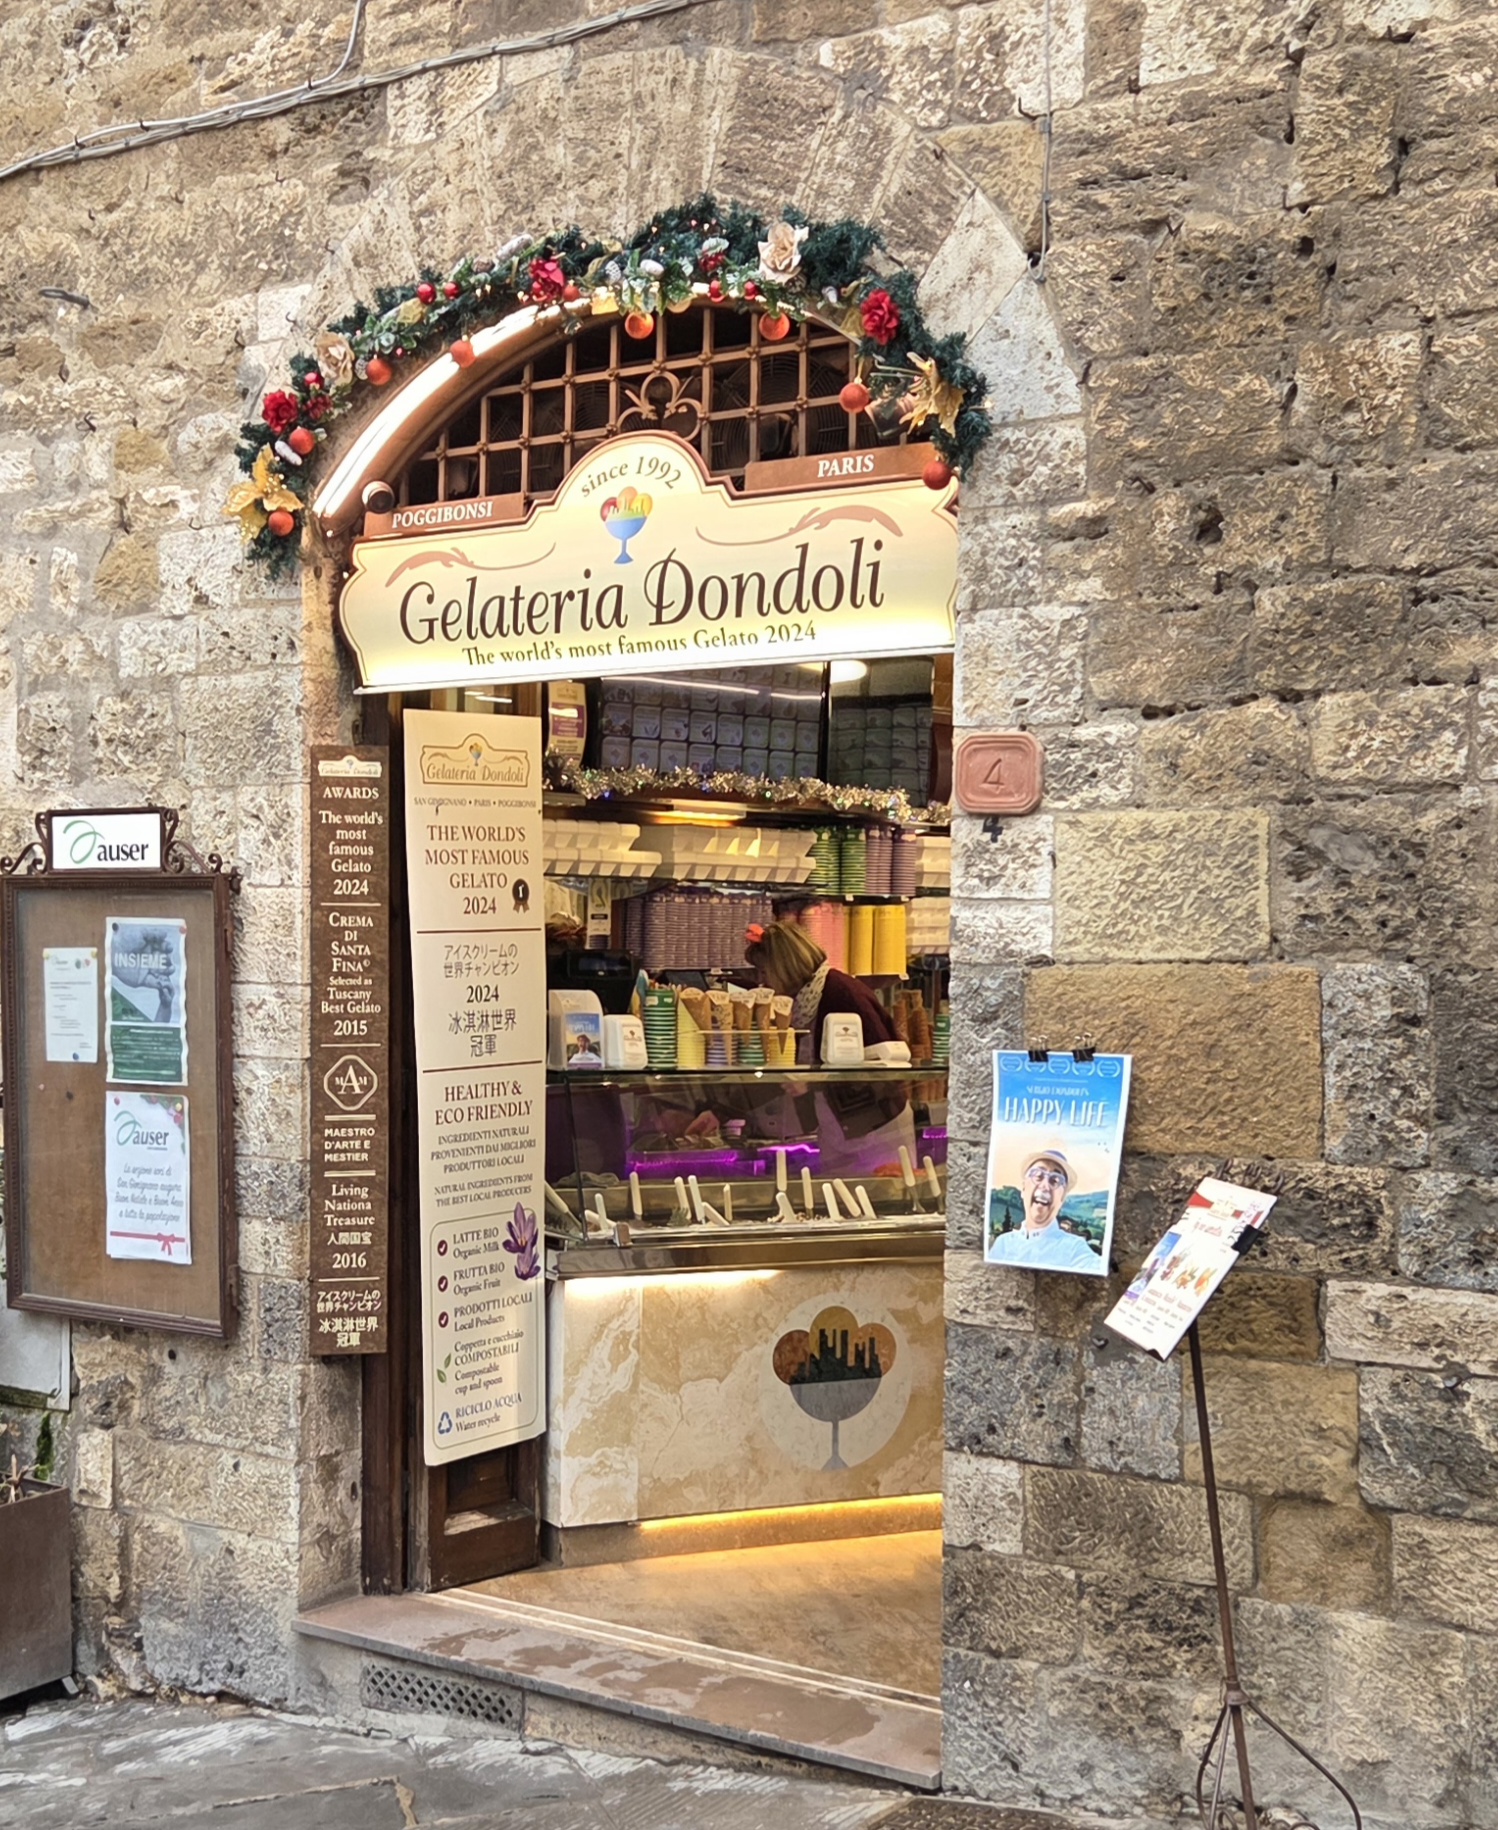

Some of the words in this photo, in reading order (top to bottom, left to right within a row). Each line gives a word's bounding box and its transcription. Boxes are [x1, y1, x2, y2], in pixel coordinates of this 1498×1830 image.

[817, 454, 875, 478] PARIS
[581, 463, 628, 497] since
[636, 456, 681, 489] 1992
[392, 501, 494, 529] POGGIBONSI
[400, 568, 628, 645] Gelateria
[644, 537, 884, 626] Dondoli
[462, 646, 495, 665] The
[500, 640, 562, 663] world's
[569, 640, 612, 658] most
[618, 635, 687, 655] famous
[694, 627, 758, 649] Gelato
[765, 620, 816, 644] 2024
[426, 763, 477, 781] Gelateria
[481, 764, 524, 783] Dondoli
[979, 758, 1005, 795] 4
[323, 786, 379, 799] AWARDS
[318, 810, 342, 824] The
[344, 811, 383, 825] world's
[336, 829, 366, 840] most
[427, 825, 460, 841] THE
[462, 825, 526, 842] WORLD'S
[97, 842, 149, 862] auser
[329, 841, 374, 855] famous
[425, 849, 468, 865] MOST
[472, 850, 529, 865] FAMOUS
[331, 858, 372, 873] Gelato
[333, 878, 369, 895] 2024
[449, 872, 508, 889] GELATO
[463, 896, 497, 915] 2024
[329, 912, 374, 927] CREMA
[344, 930, 358, 941] DI
[331, 941, 371, 956] SANTA
[443, 943, 518, 961] アイスクリームの
[114, 952, 168, 969] INSIEME
[443, 959, 520, 979] 世界チャンピオン
[329, 976, 362, 986] Selected
[363, 978, 372, 986] as
[327, 987, 372, 1003] Tuscany
[466, 984, 500, 1003] 2024
[321, 1001, 344, 1014] Best
[347, 1001, 381, 1014] Gelato
[333, 1019, 368, 1036] 2015
[448, 1007, 517, 1035] 冰淇淋世界
[470, 1033, 498, 1058] 冠軍
[445, 1081, 510, 1102] HEALTHY
[511, 1080, 522, 1096] &
[435, 1107, 465, 1126] ECO
[467, 1099, 533, 1122] FRIENDLY
[1004, 1096, 1064, 1126] HAPPY
[1070, 1099, 1109, 1128] LIFE
[132, 1130, 169, 1146] auser
[324, 1128, 375, 1137] MAESTRO
[438, 1130, 491, 1145] INGREDIENTI
[492, 1125, 529, 1139] NATURALI
[324, 1140, 361, 1150] D'ARTE
[363, 1140, 371, 1149] E
[431, 1146, 485, 1161] PROVENIENTI
[324, 1153, 369, 1162] MESTIER
[443, 1157, 496, 1174] PRODUTTORI
[497, 1153, 525, 1167] LOCALI
[332, 1184, 369, 1199] Living
[434, 1182, 465, 1195] NATURAL
[467, 1175, 513, 1191] INGREDIENTS
[514, 1172, 533, 1183] FROM
[436, 1196, 451, 1207] THE
[452, 1194, 468, 1205] BEST
[469, 1190, 491, 1202] LOCAL
[492, 1185, 532, 1199] PRODUCERS
[323, 1214, 376, 1226] Treasure
[453, 1229, 482, 1244] LATTE
[484, 1226, 499, 1239] BIO
[453, 1244, 482, 1260] Organic
[484, 1241, 500, 1253] Milk
[332, 1252, 367, 1269] 2016
[453, 1266, 488, 1281] FRUTTA
[489, 1261, 505, 1274] BIO
[317, 1289, 381, 1303] アイスクリームの
[453, 1281, 482, 1297] Organic
[484, 1278, 501, 1290] Fruit
[454, 1299, 500, 1318] PRODOTTI
[502, 1291, 532, 1308] LOCALI
[454, 1318, 474, 1332] Local
[475, 1314, 505, 1328] Products
[454, 1338, 486, 1354] Coppetta
[454, 1341, 519, 1367] COMPOSTABILI
[454, 1361, 500, 1381] Compostable
[454, 1384, 468, 1396] cup
[469, 1378, 481, 1391] and
[455, 1399, 492, 1419] RICICLO
[494, 1391, 522, 1408] ACQUA
[455, 1419, 476, 1432] Water
[478, 1412, 501, 1428] recycle
